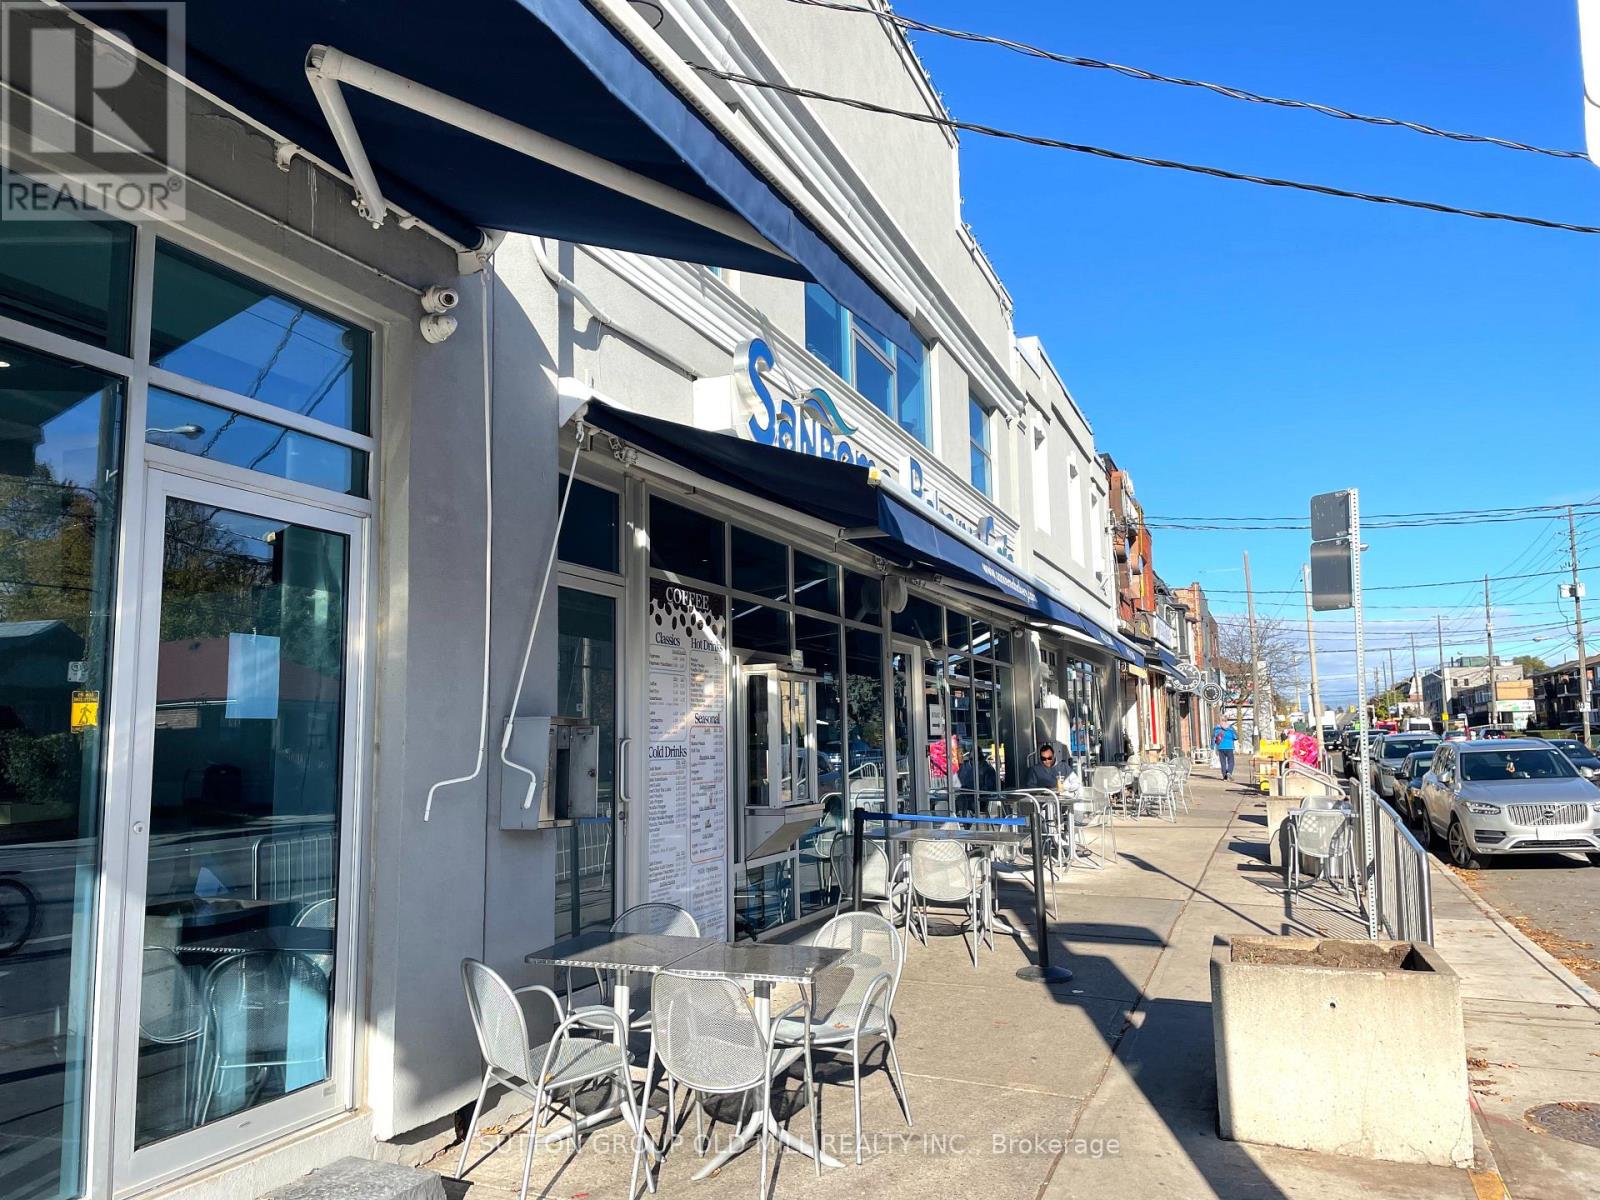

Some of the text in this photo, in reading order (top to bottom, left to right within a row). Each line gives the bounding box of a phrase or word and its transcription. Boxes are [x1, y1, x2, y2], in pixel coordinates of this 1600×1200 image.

[665, 586, 710, 610] COFFEE
[655, 632, 681, 646] Classics
[690, 637, 703, 649] Hot
[694, 712, 721, 725] Seasonal
[664, 744, 688, 758] Drinks
